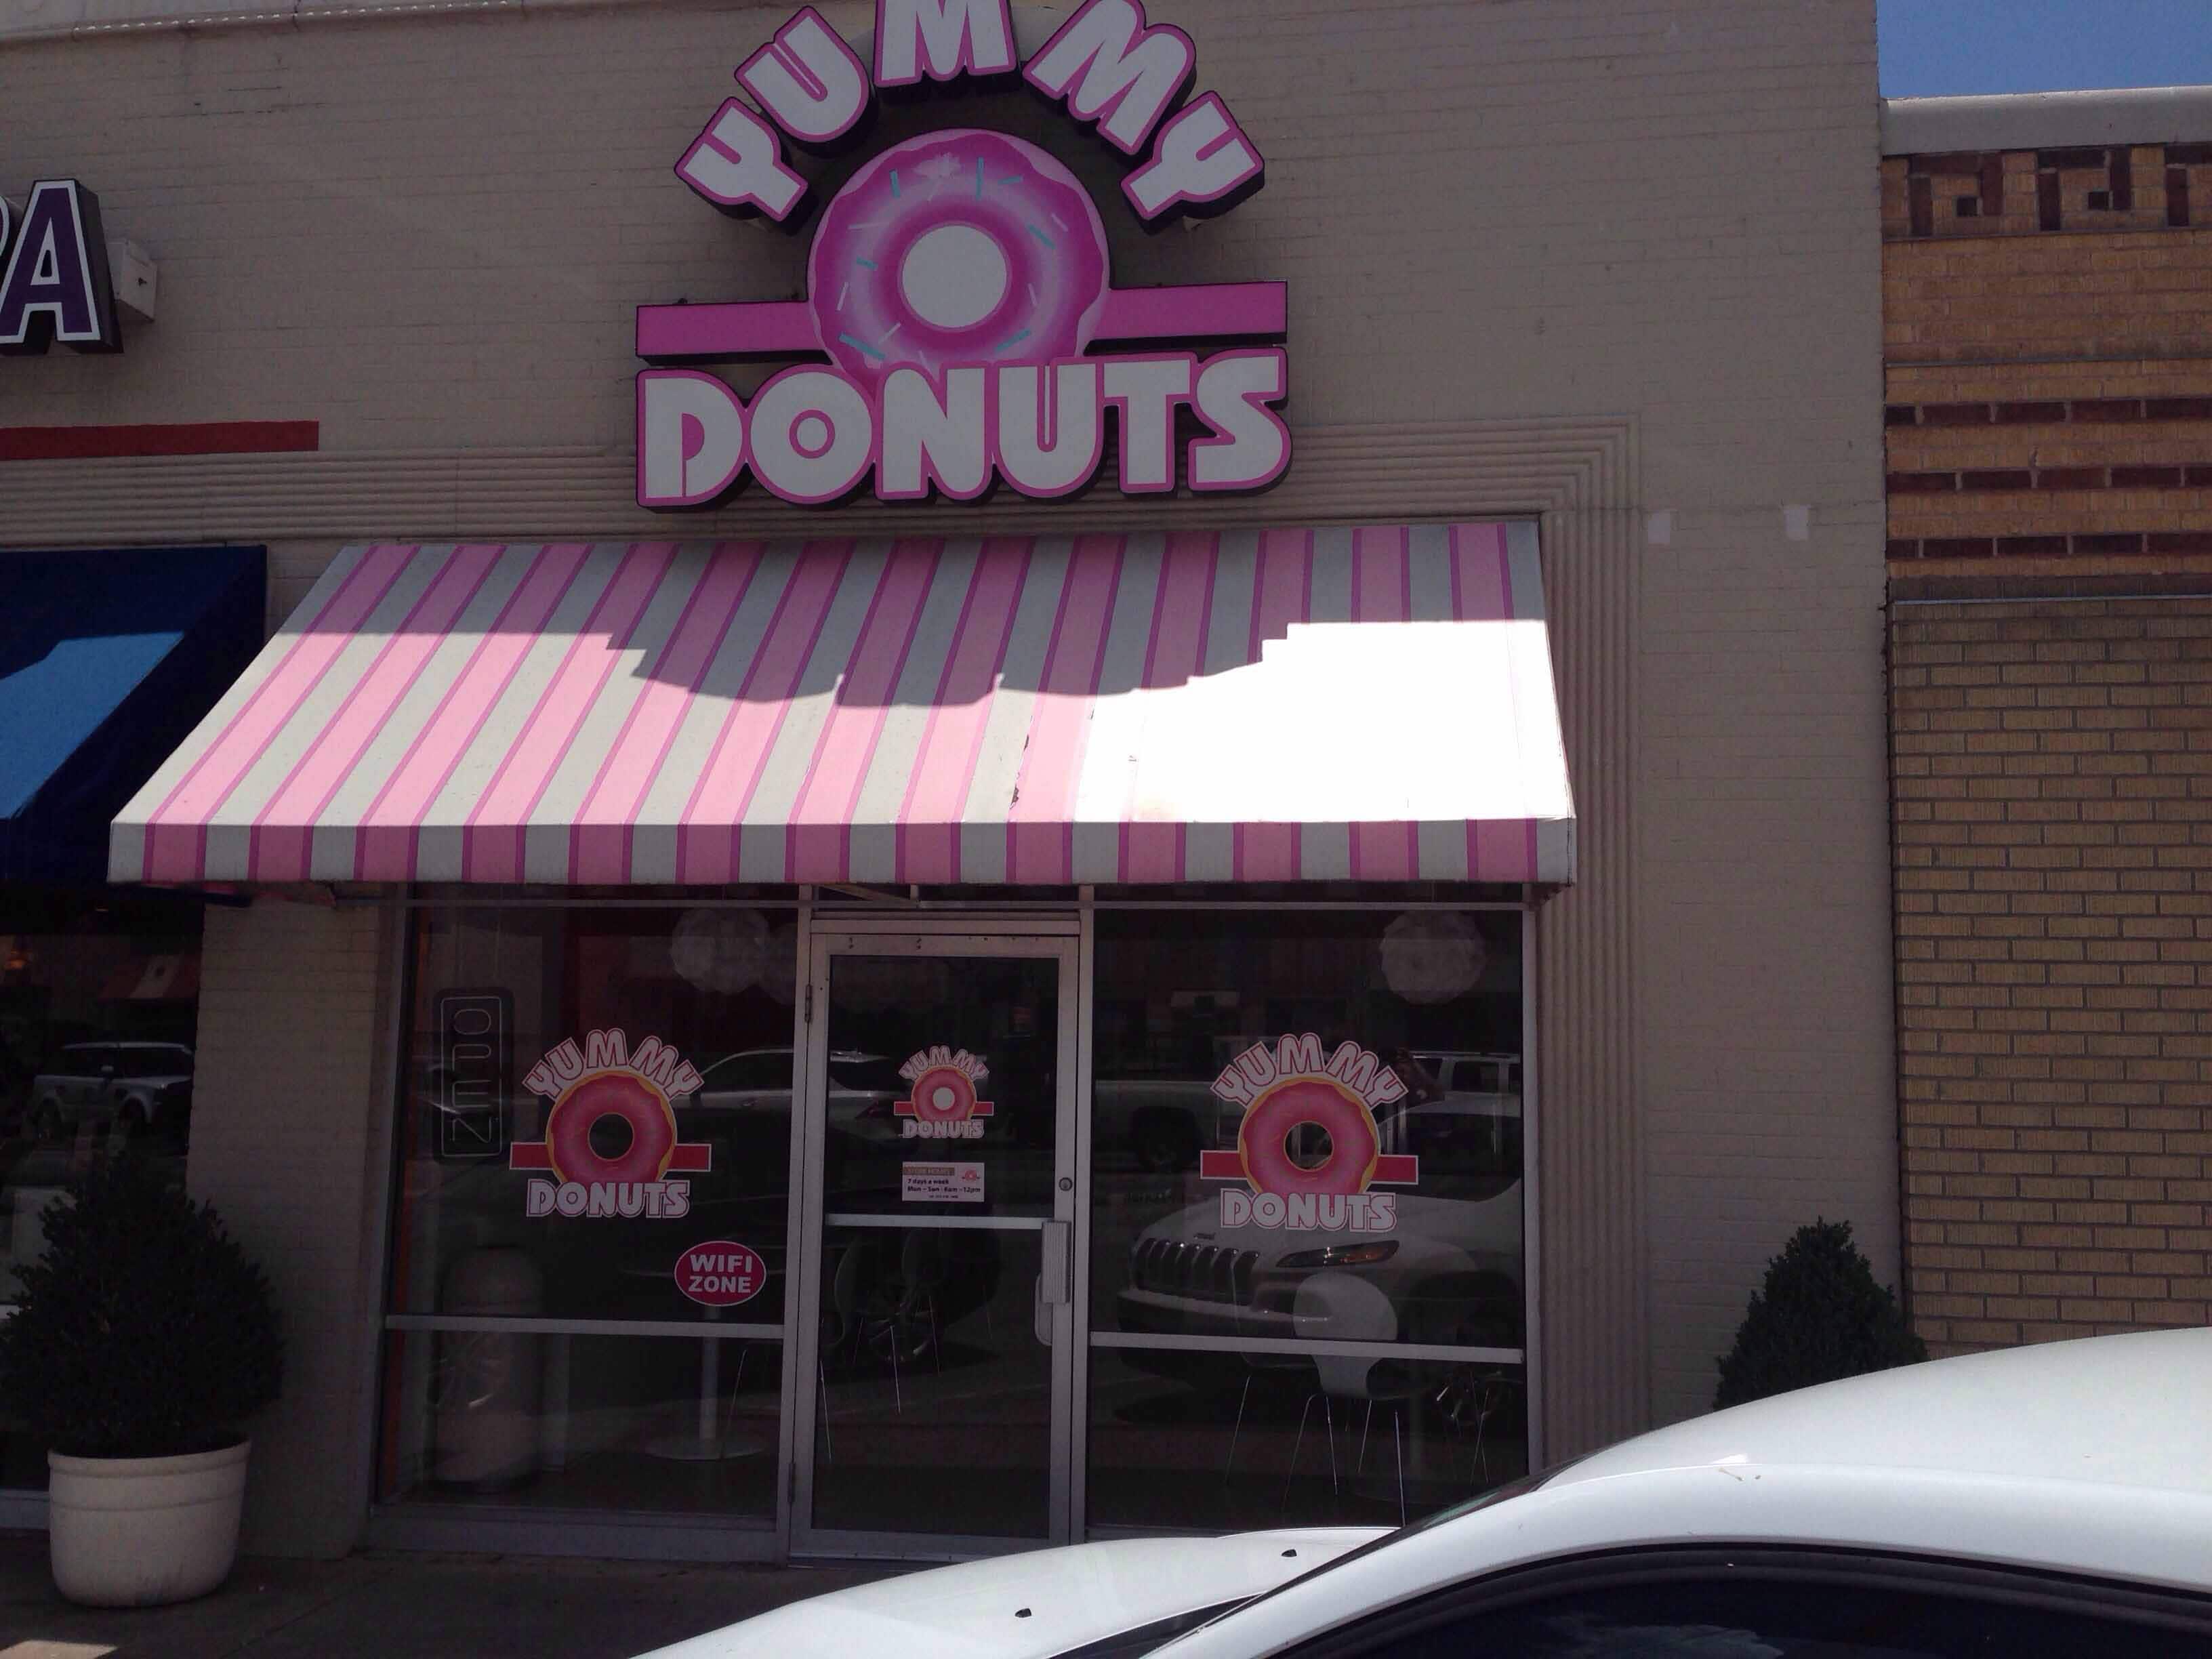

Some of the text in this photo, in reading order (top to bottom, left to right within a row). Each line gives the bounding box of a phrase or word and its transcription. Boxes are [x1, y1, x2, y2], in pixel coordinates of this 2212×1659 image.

[674, 0, 1265, 224] YUMMY
[636, 348, 1292, 507] DONUTS
[452, 1008, 492, 1144] OPEN
[522, 1028, 705, 1101] YUMMY
[899, 1045, 989, 1081] YUMMY
[1210, 1032, 1408, 1109] YUMMY
[903, 1119, 985, 1139] DONUTS
[526, 1179, 690, 1218] DONUTS
[1220, 1188, 1396, 1232] DONUTS
[688, 1275, 752, 1293] ZONE
[689, 1254, 752, 1273] WIFI
